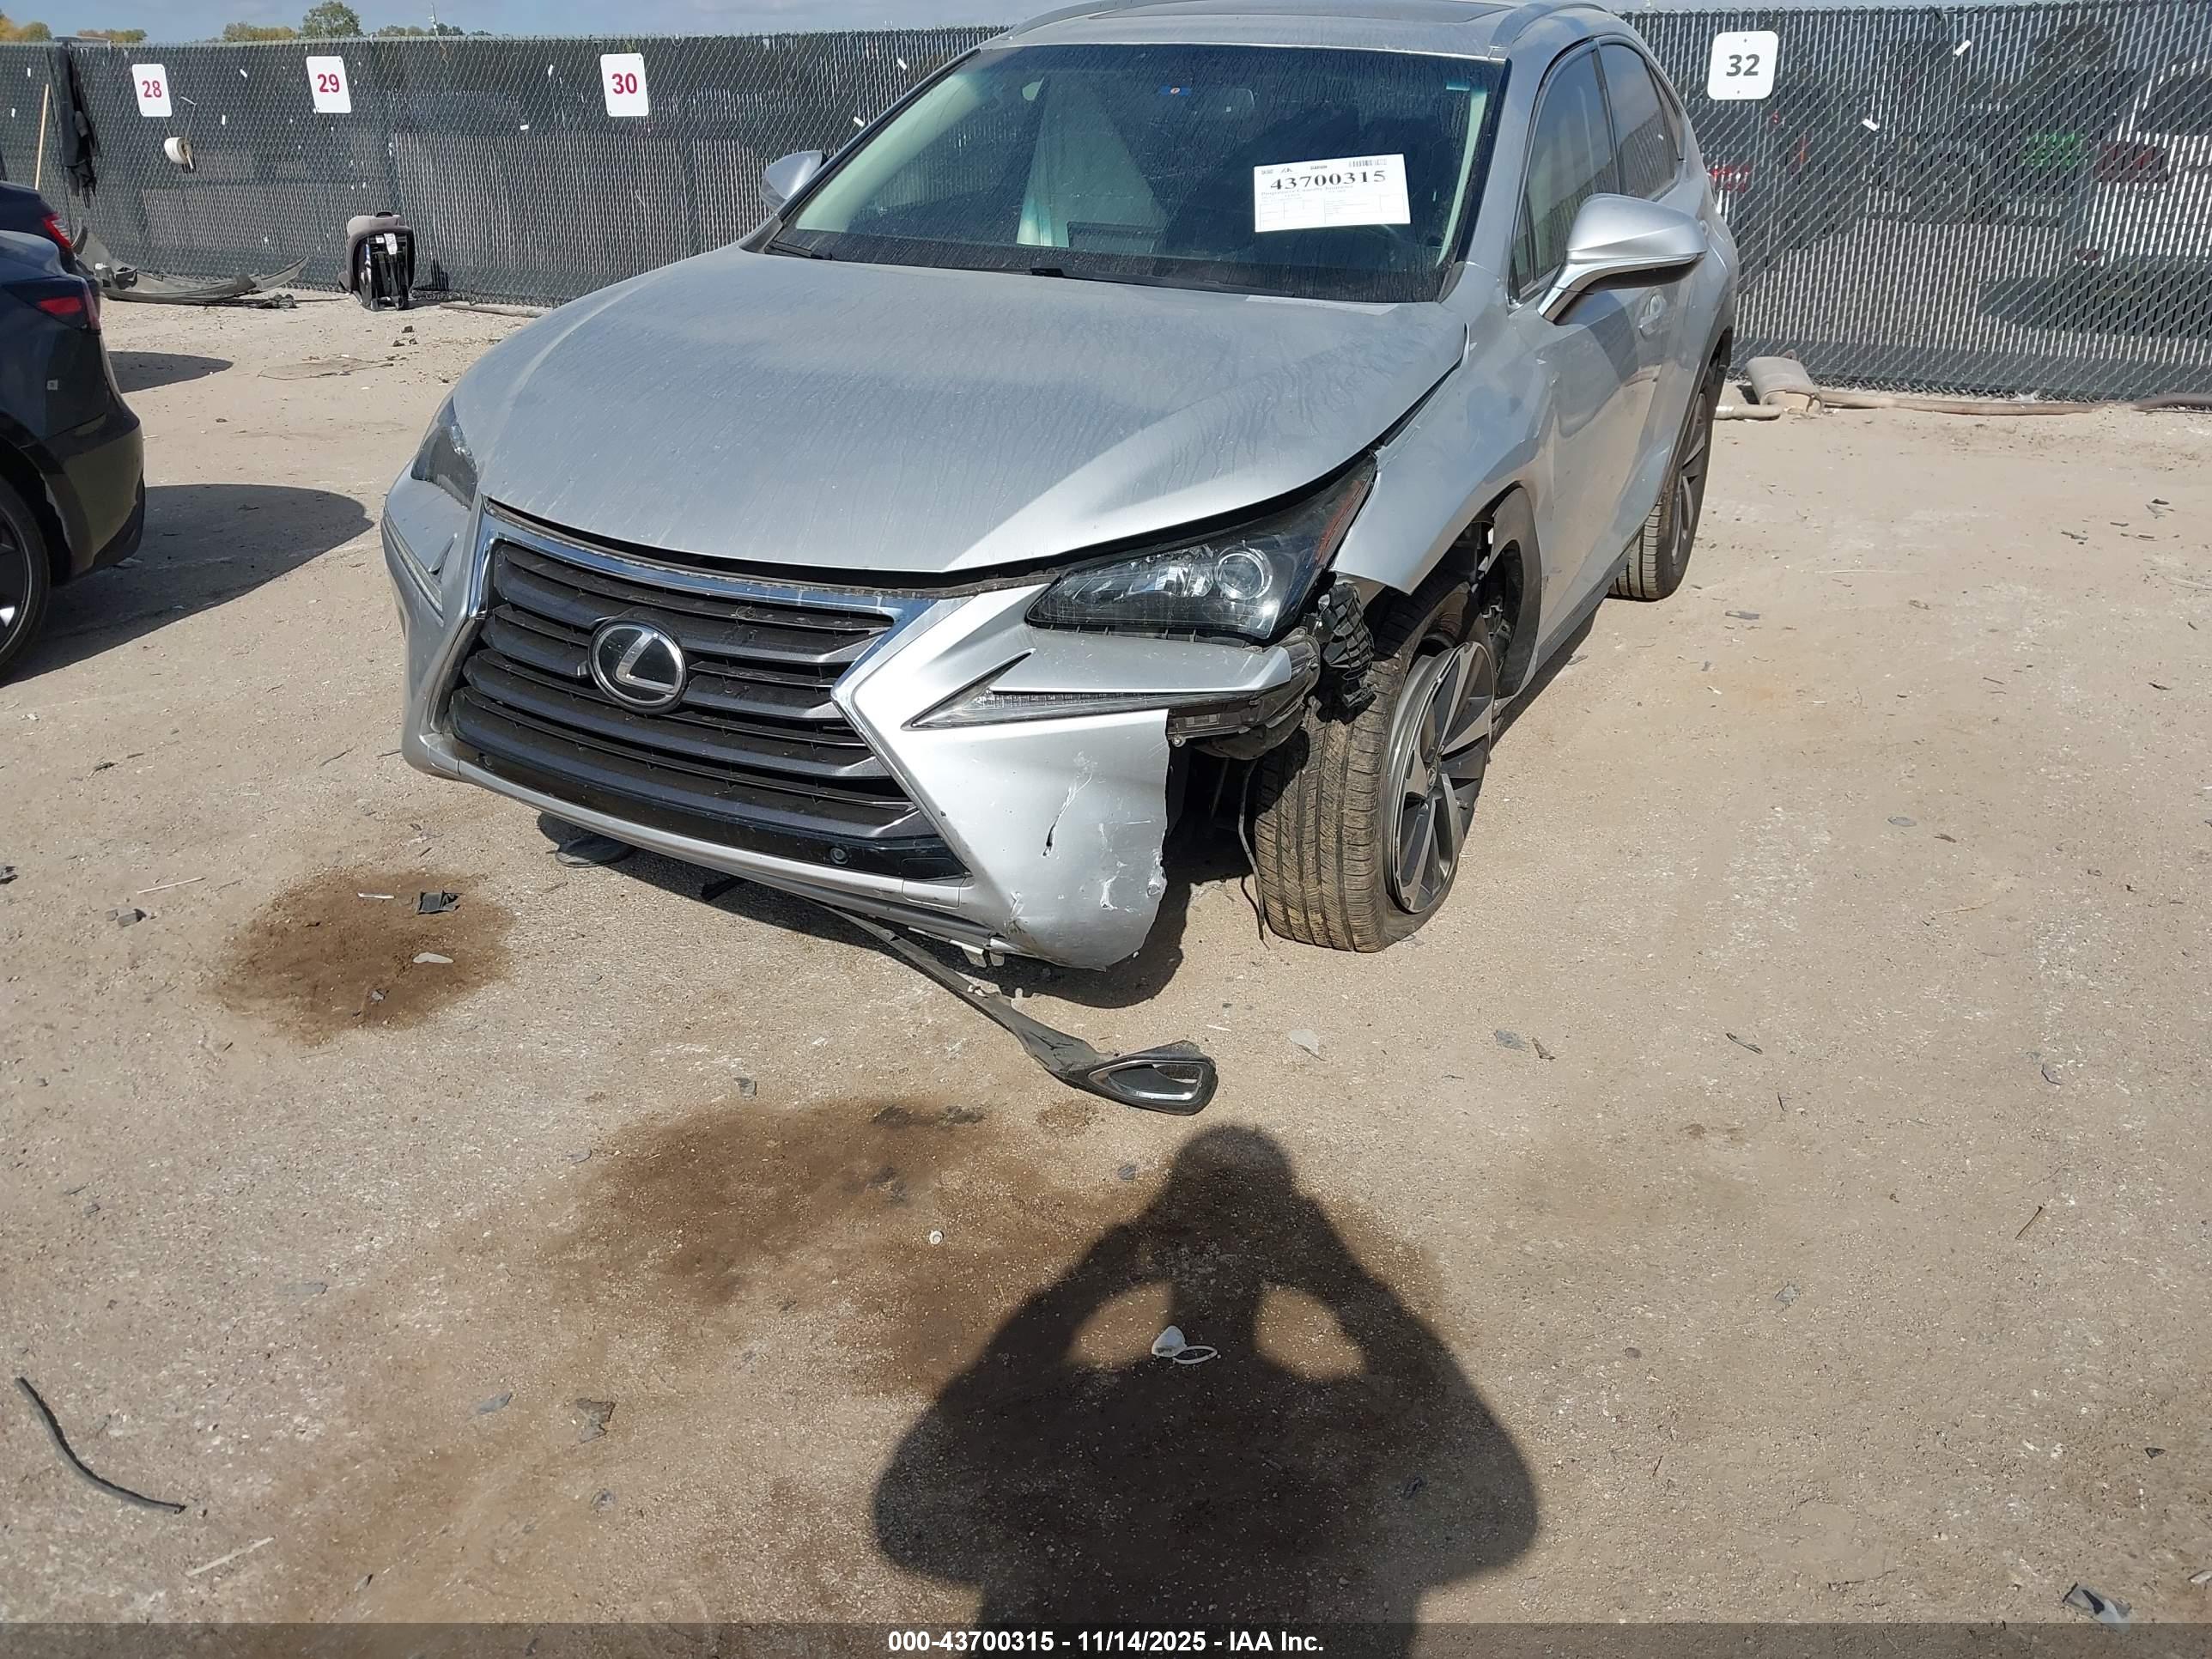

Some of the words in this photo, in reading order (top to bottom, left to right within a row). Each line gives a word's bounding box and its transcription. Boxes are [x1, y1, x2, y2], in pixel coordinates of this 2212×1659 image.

[1726, 53, 1760, 77] 32
[143, 81, 162, 98] 28
[317, 72, 339, 94] 29
[612, 72, 639, 94] 30
[1270, 169, 1387, 191] 43700315
